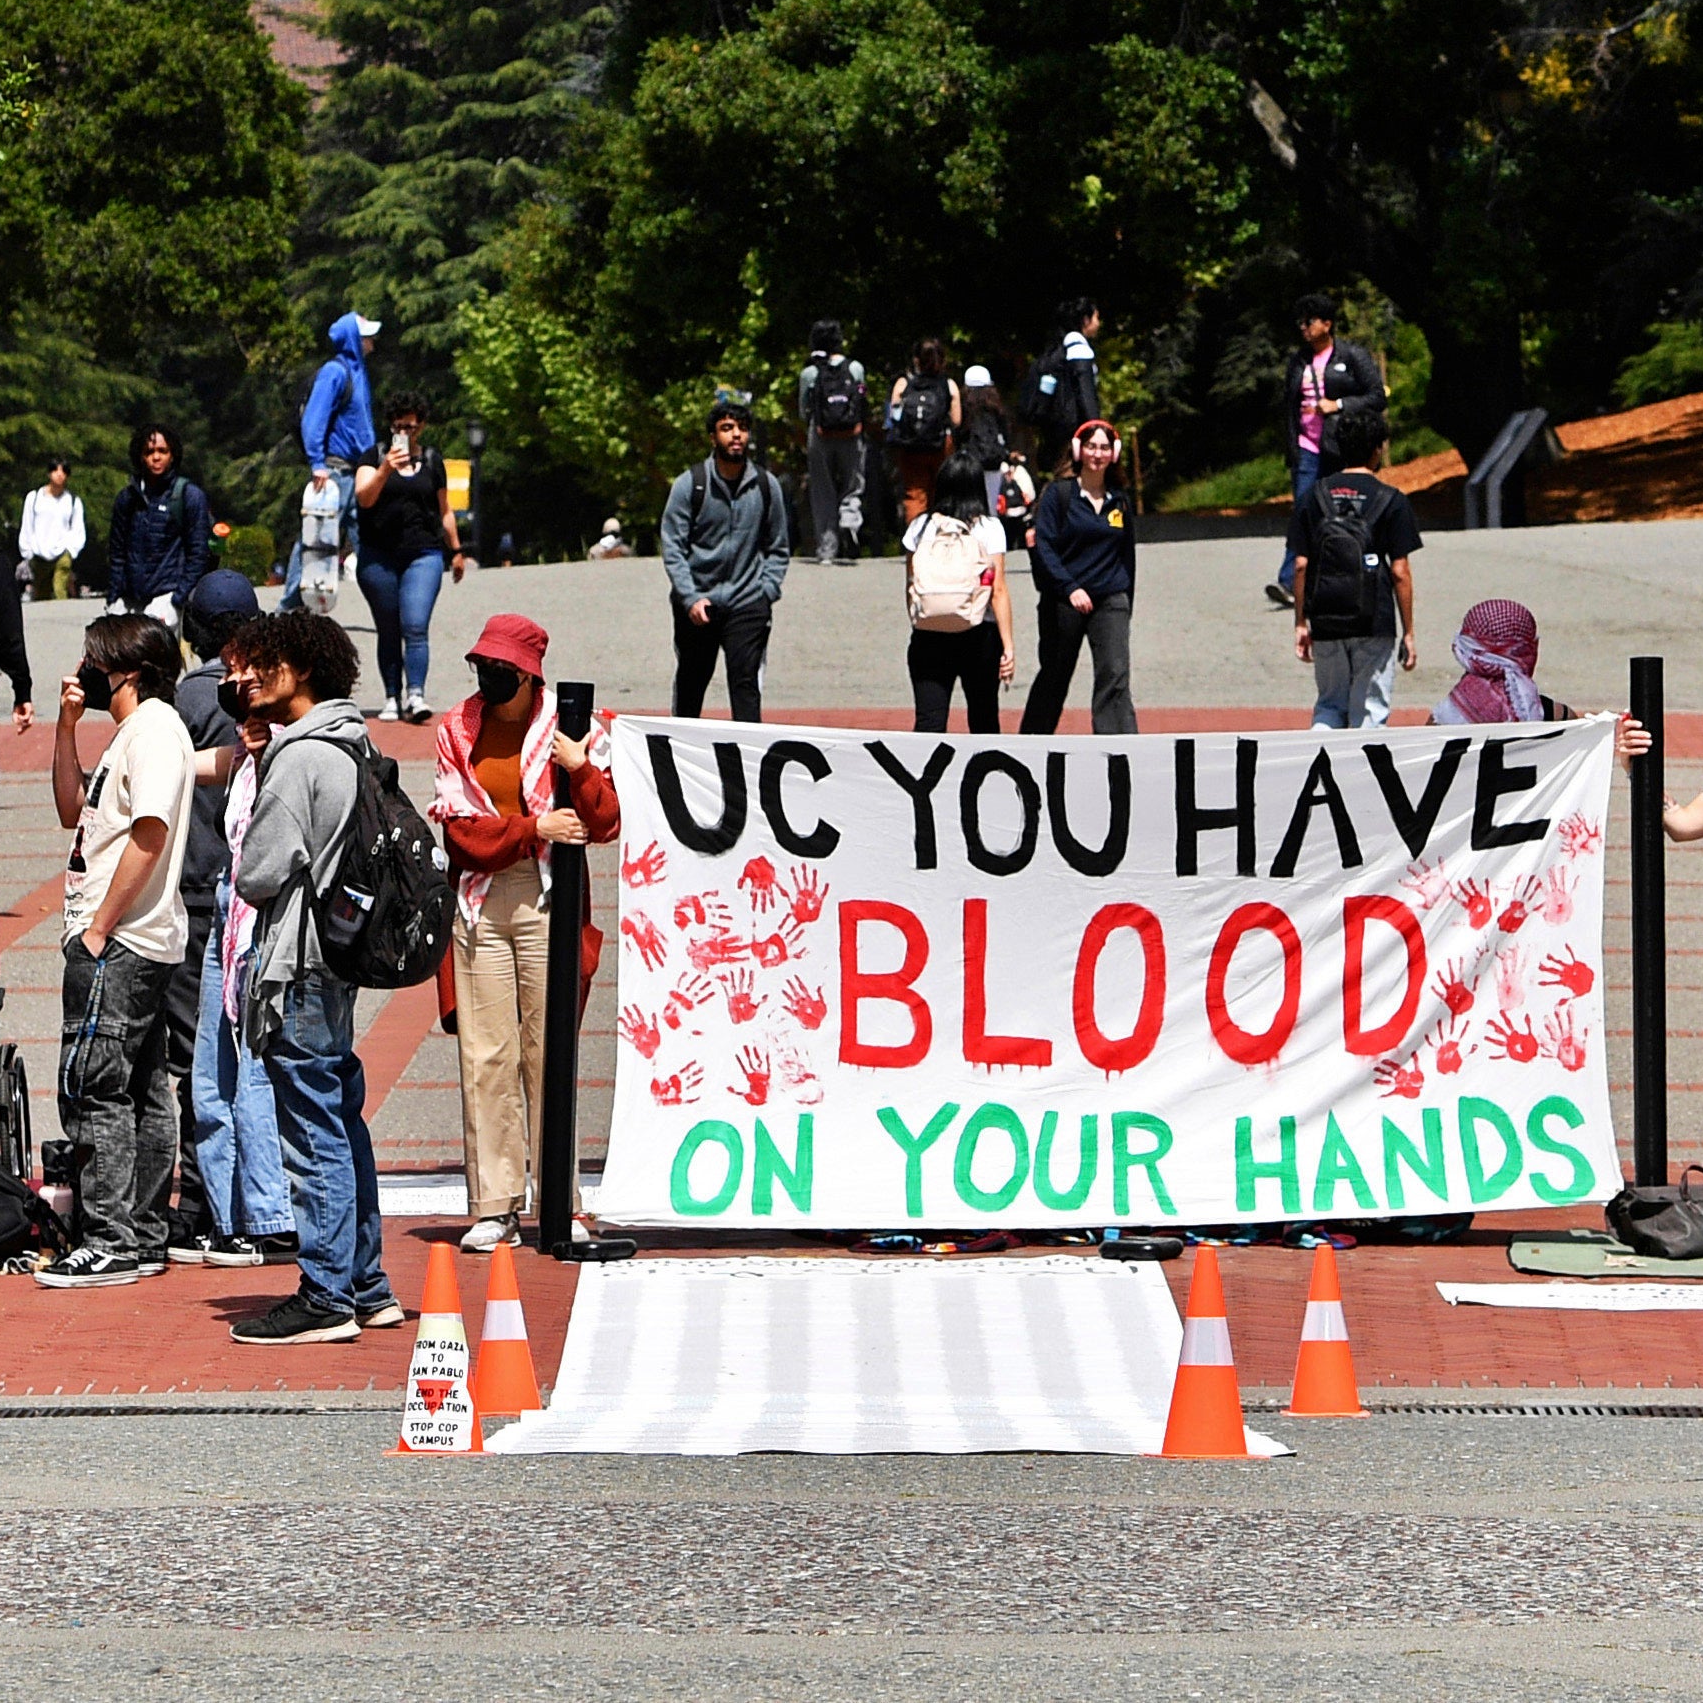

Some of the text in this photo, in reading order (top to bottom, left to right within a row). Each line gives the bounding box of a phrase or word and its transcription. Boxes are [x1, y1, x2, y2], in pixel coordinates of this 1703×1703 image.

[646, 733, 1565, 879] UC YOU HAVE
[837, 896, 1428, 1073] BLOOD
[670, 1095, 1597, 1217] ON YOUR HANDS
[439, 1340, 464, 1353] GAZA
[431, 1353, 444, 1363] TO
[412, 1366, 464, 1379] SAN PABLO
[416, 1388, 459, 1399] END THE
[407, 1401, 468, 1414] OCCUPATION
[410, 1422, 459, 1432] STOP COP
[412, 1435, 454, 1447] CAMPUS
